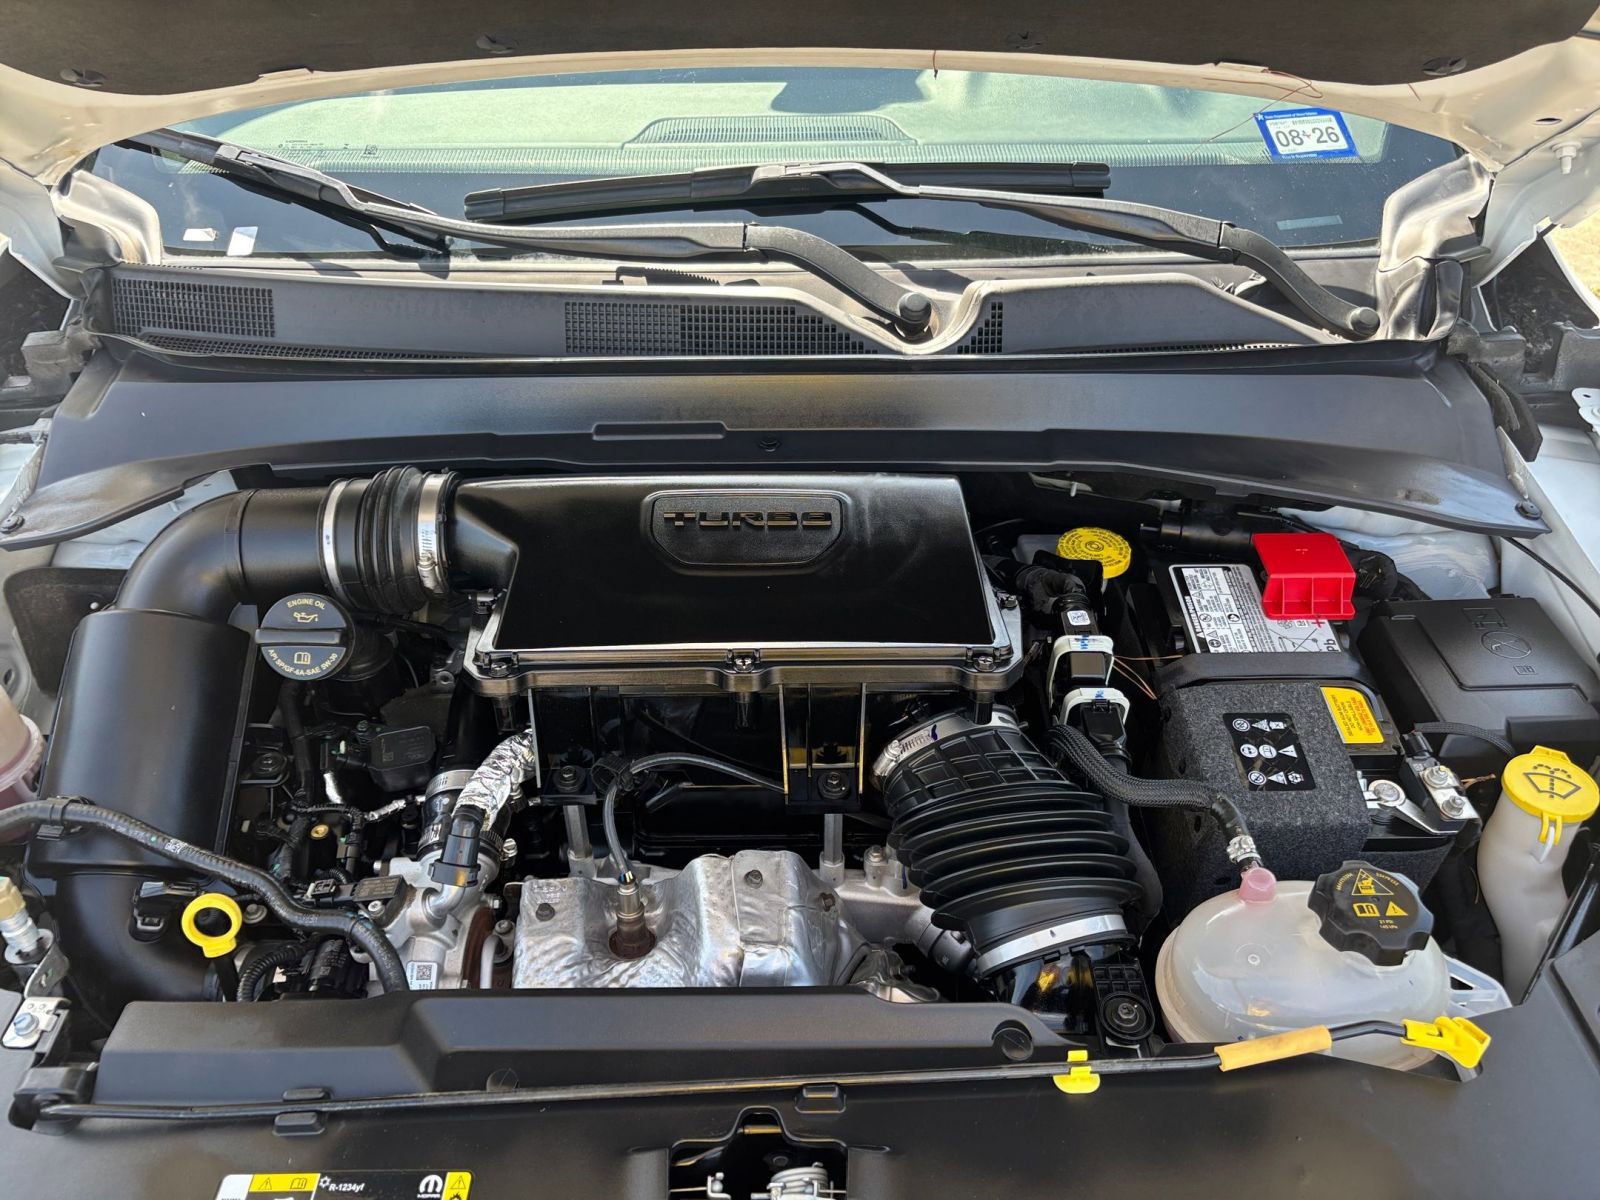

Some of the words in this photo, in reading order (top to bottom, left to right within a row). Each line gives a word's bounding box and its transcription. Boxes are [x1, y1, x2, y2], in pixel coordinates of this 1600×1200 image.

[1275, 129, 1304, 147] 08
[1311, 126, 1340, 144] 26
[663, 511, 833, 528] TURBO
[287, 598, 313, 608] ENGINE
[314, 600, 326, 610] OIL
[268, 649, 278, 661] API
[321, 653, 338, 670] 5W-30
[329, 1183, 365, 1193] R-1234yf
